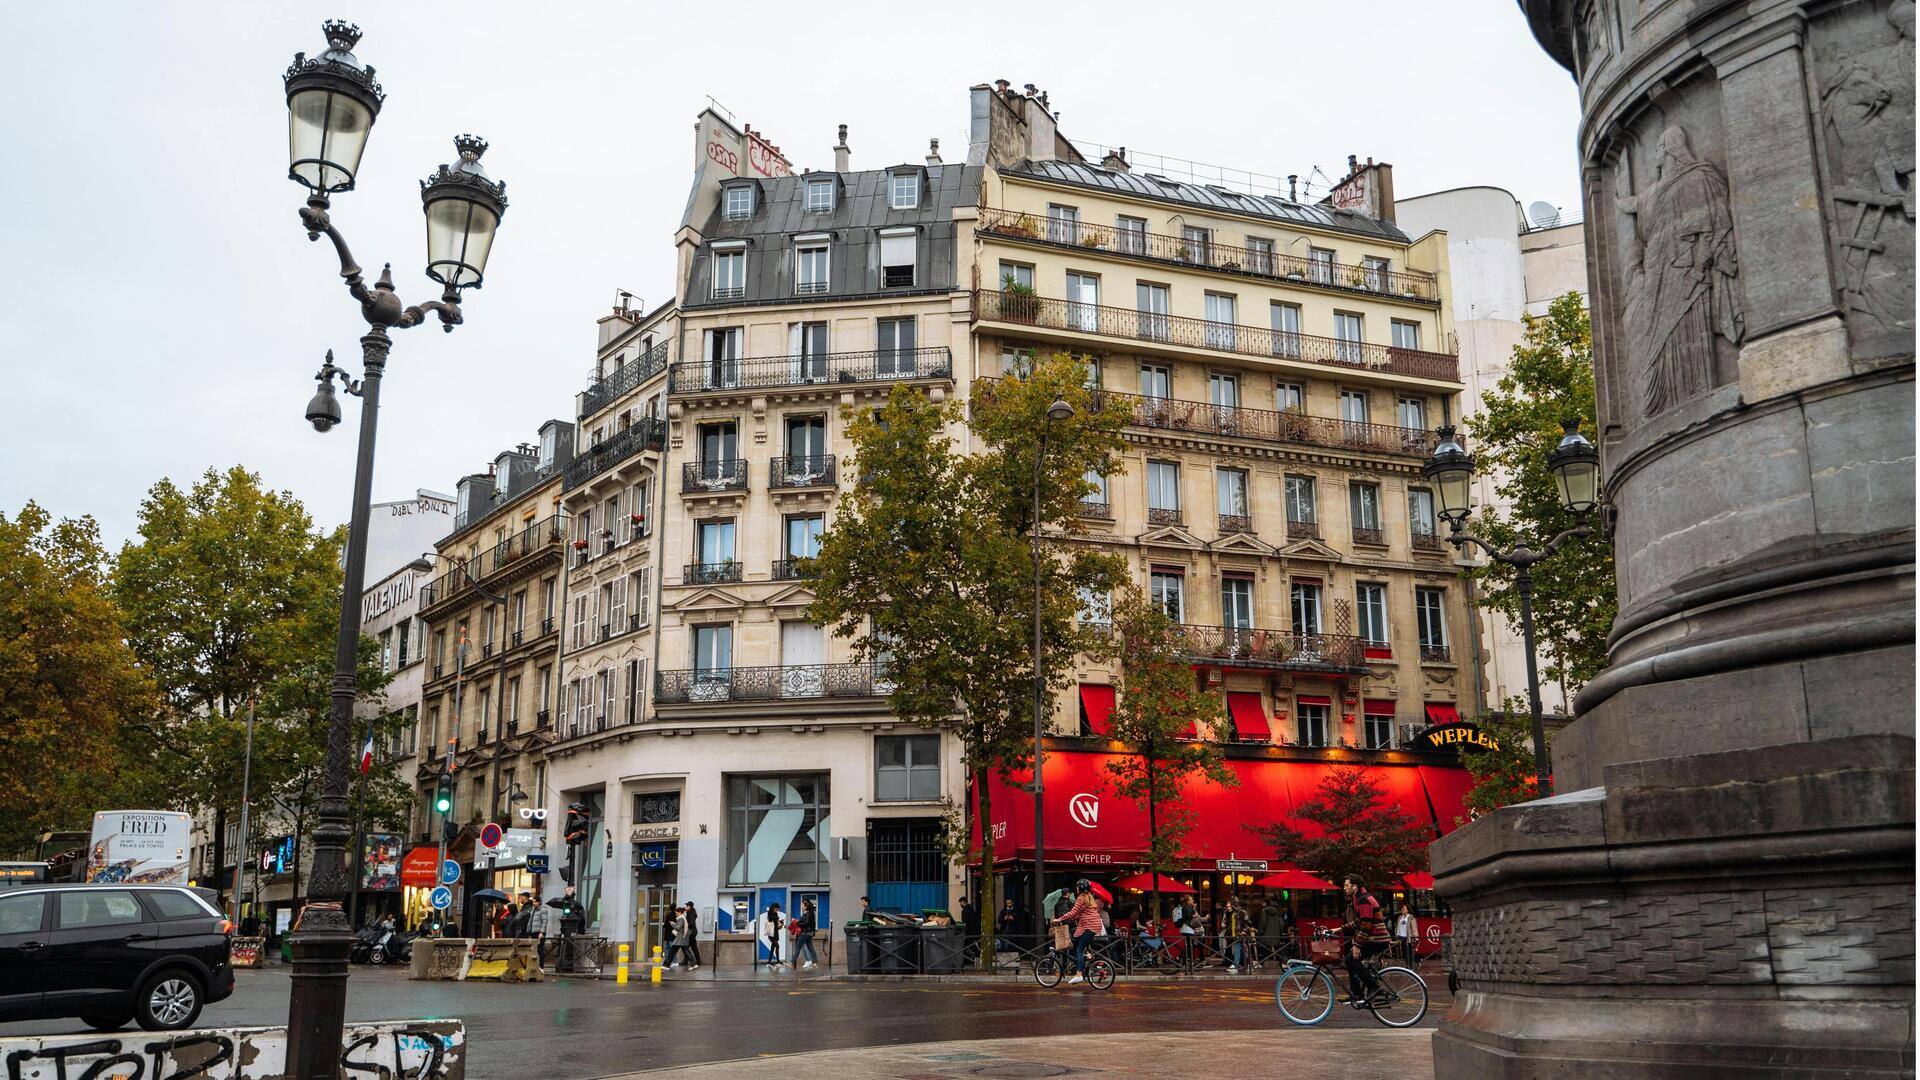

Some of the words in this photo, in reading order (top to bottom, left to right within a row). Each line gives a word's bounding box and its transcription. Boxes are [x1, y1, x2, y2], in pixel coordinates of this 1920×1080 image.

[361, 571, 414, 624] VALENTIN
[121, 821, 167, 834] FRED
[991, 821, 1007, 840] PLER
[644, 851, 661, 859] LCL
[1075, 854, 1111, 864] WEPLER
[528, 858, 546, 866] LCL
